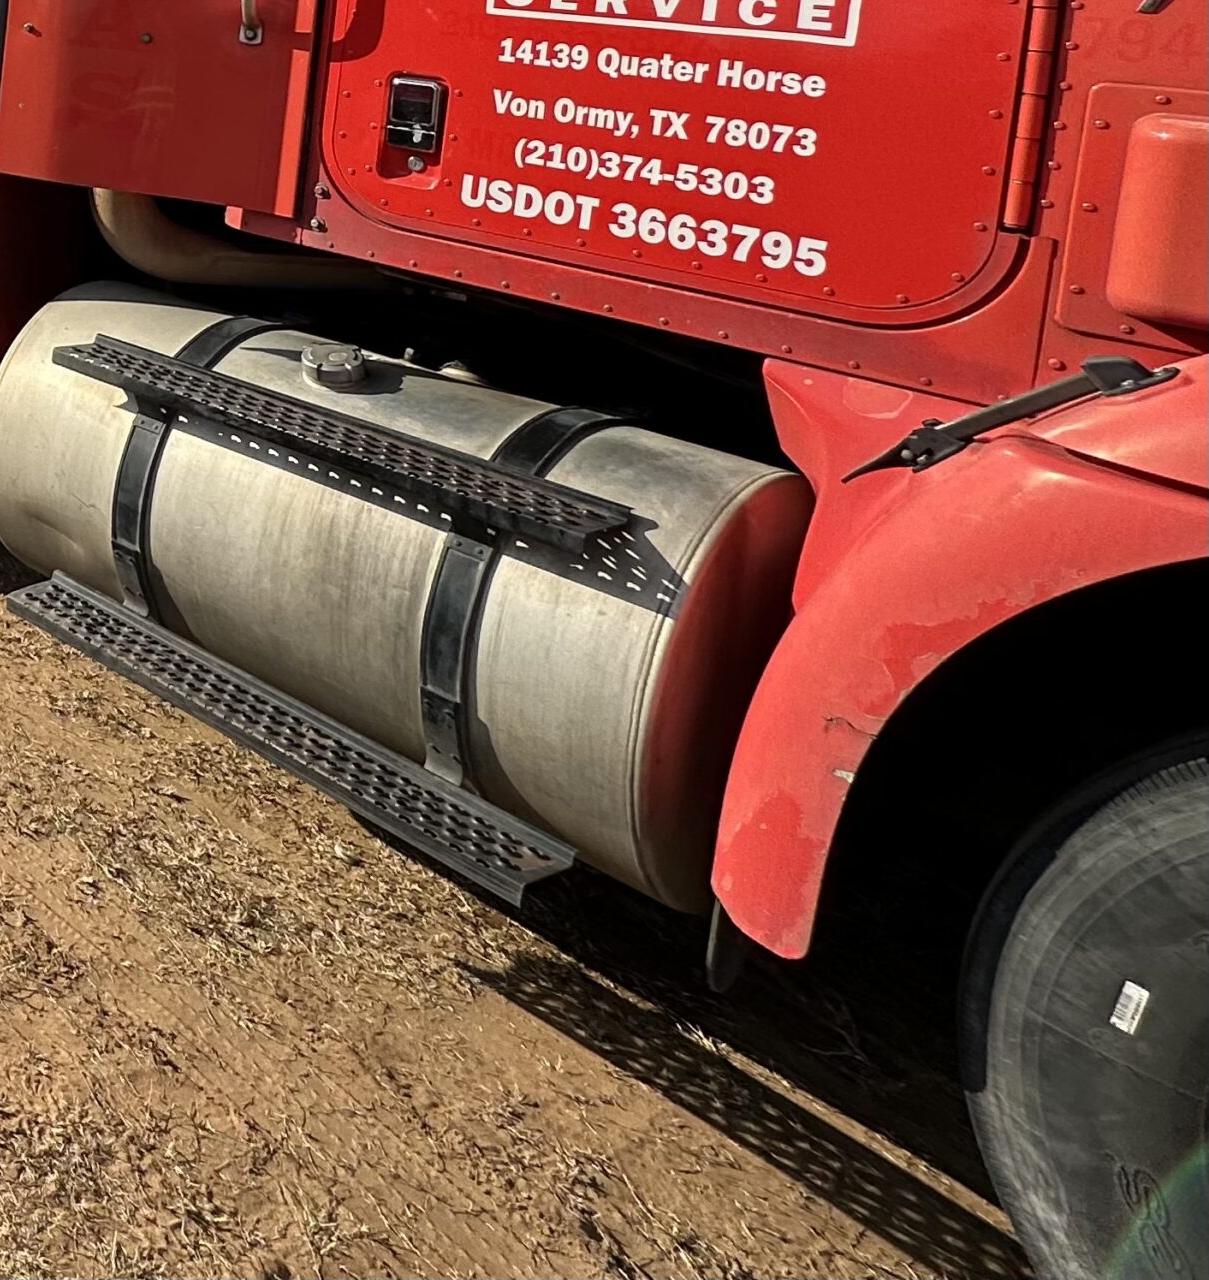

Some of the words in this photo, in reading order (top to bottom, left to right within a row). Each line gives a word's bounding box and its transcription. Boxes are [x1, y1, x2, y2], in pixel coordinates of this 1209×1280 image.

[498, 37, 589, 71] 14139
[597, 47, 710, 84] Quater
[717, 59, 827, 98] Horse
[493, 88, 546, 120] Von
[553, 97, 640, 139] Ormy,
[649, 109, 690, 140] TX
[705, 115, 818, 157] 78073
[514, 138, 776, 206] (210)374-5303
[460, 174, 601, 231] USDOT
[608, 202, 829, 278] 3663795
